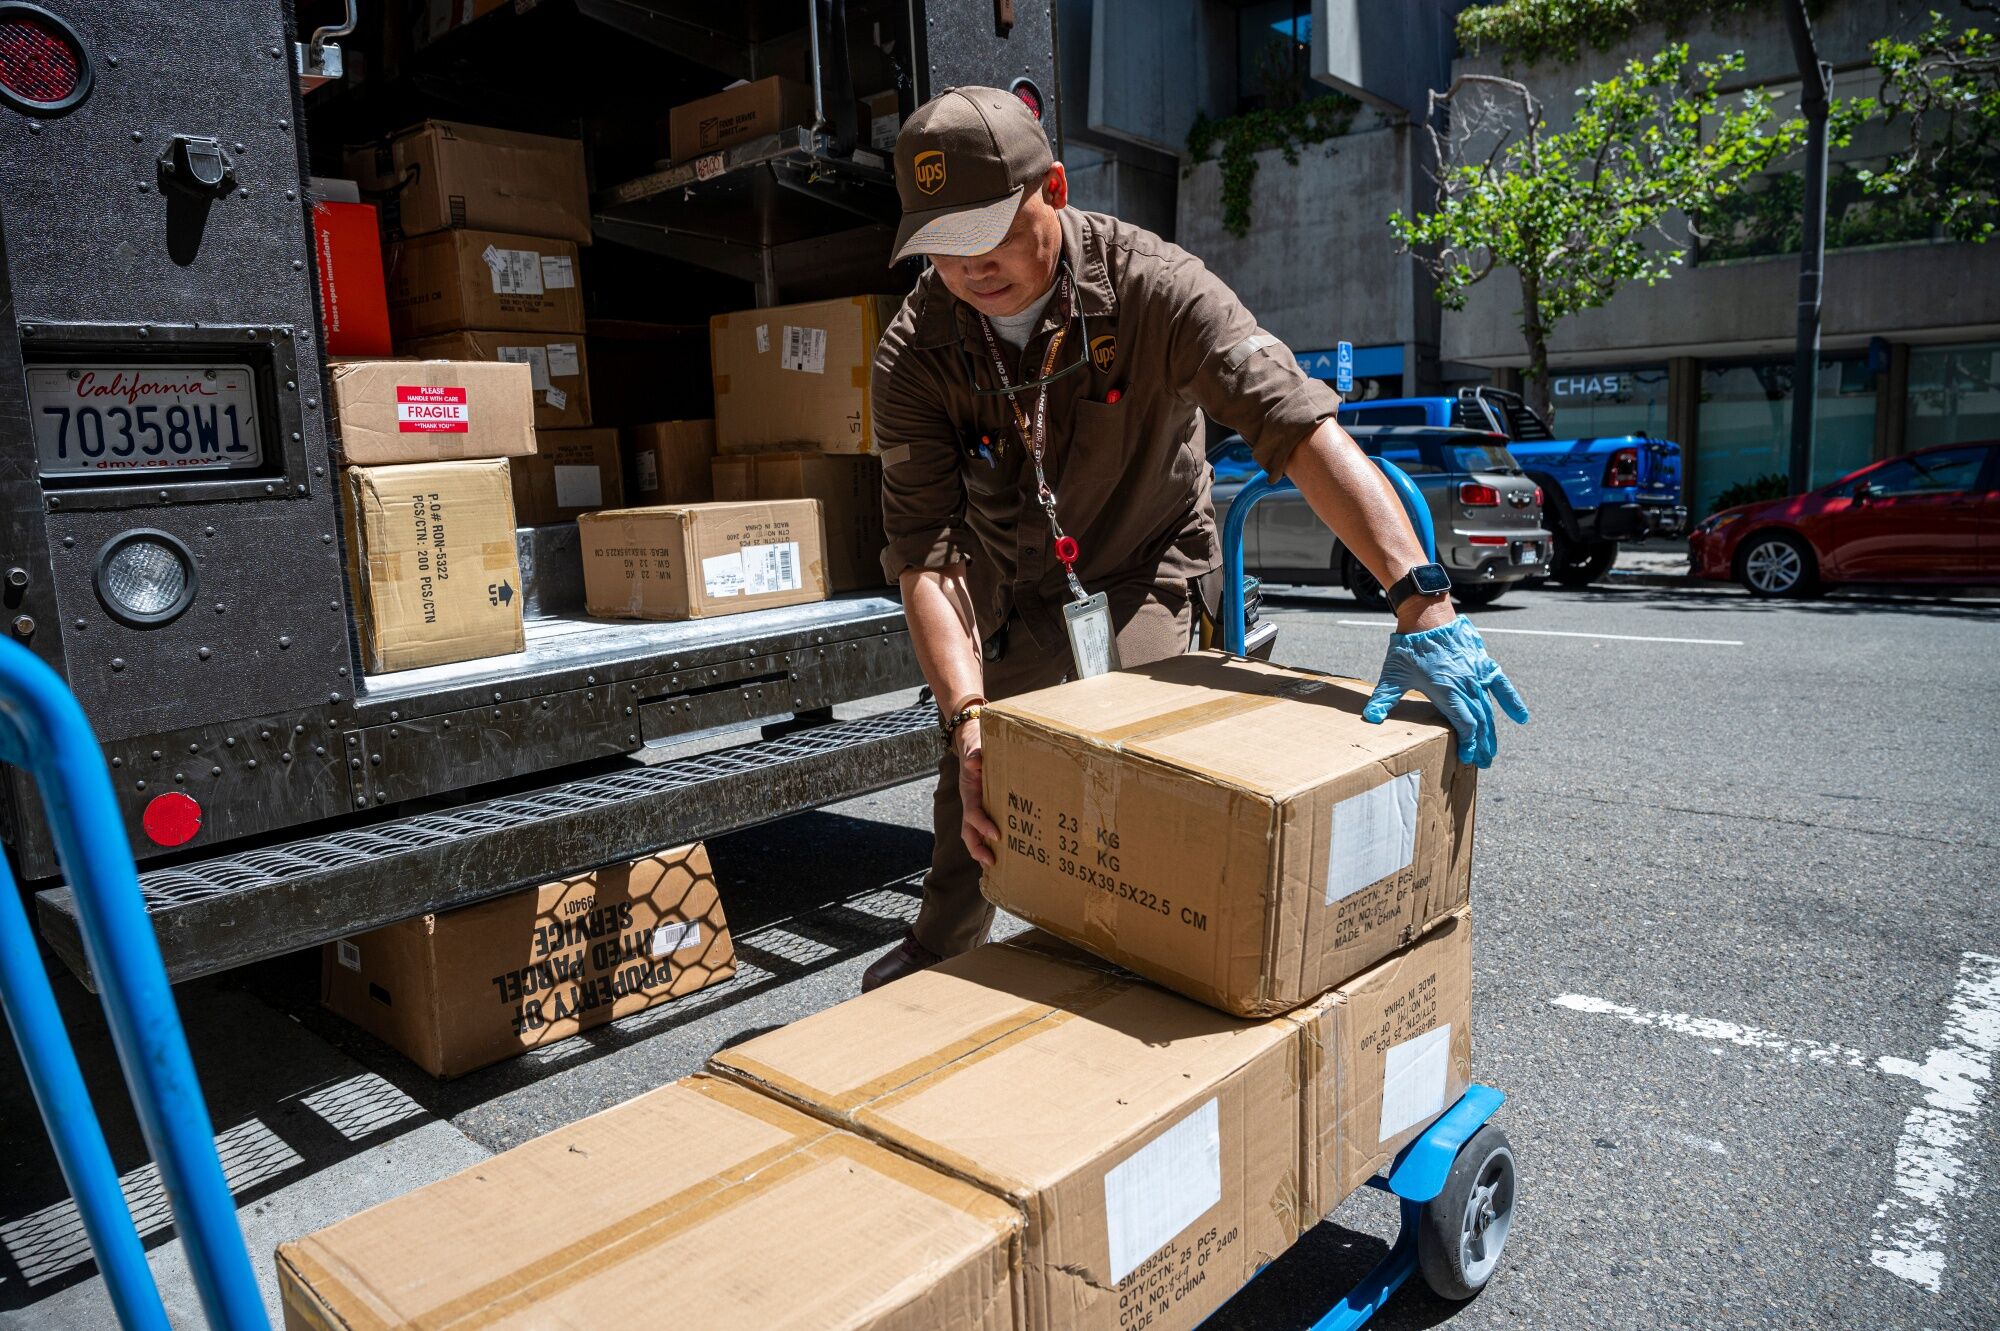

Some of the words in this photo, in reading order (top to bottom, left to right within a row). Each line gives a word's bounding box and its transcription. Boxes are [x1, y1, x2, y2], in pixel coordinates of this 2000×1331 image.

[322, 229, 334, 281] immediately
[329, 282, 337, 303] open
[330, 306, 340, 332] Please
[996, 361, 1006, 374] ON
[1554, 376, 1634, 395] CHASE
[77, 372, 217, 404] California
[408, 406, 459, 418] FRAGILE
[43, 405, 248, 458] 70358W1
[412, 495, 426, 545] PCS/CTN:
[418, 550, 429, 570] 200
[432, 525, 448, 580] RON-5322
[420, 577, 436, 623] PCS/CTN
[488, 584, 497, 606] UP
[1008, 792, 1040, 819] N.W.:
[1059, 813, 1078, 833] 2.3
[1097, 827, 1120, 849] KG
[1008, 814, 1041, 840] G.W.:
[1059, 835, 1079, 856] 3.2
[1097, 850, 1120, 872] KG
[1008, 835, 1050, 866] MEAS:
[1059, 858, 1170, 915] 39.5X39.5X22.5
[1181, 906, 1207, 931] CM
[1385, 881, 1394, 894] 25
[1398, 870, 1413, 887] PCS
[564, 894, 597, 915] 199401
[1336, 916, 1354, 933] CTN
[1397, 888, 1408, 901] OF
[534, 902, 633, 956] SERVICE
[1334, 927, 1360, 949] MADE
[1364, 920, 1372, 933] IN
[1377, 905, 1401, 926] CHINA
[593, 925, 655, 971] NITED
[492, 950, 585, 1004] PARCEL
[554, 959, 672, 1020] PROPERTY
[1408, 988, 1415, 1001] IN
[1418, 973, 1436, 993] MADE
[1423, 987, 1436, 1003] CTN
[511, 999, 544, 1036] OF
[1384, 996, 1404, 1018] CHINA
[1360, 1031, 1376, 1051] 2400
[1376, 1036, 1390, 1054] PCS
[1381, 1022, 1390, 1035] OF
[1394, 1027, 1402, 1040] 25
[1119, 1242, 1178, 1292] SM-6924CL
[1120, 1263, 1174, 1309] Q'TY/CTN:
[1180, 1247, 1192, 1264] 25
[1197, 1227, 1217, 1250] PCS
[1120, 1304, 1143, 1326] CTN
[1198, 1248, 1212, 1267] OF
[1217, 1227, 1238, 1253] 2400
[1159, 1298, 1169, 1315] IN
[1175, 1271, 1206, 1302] CHINA
